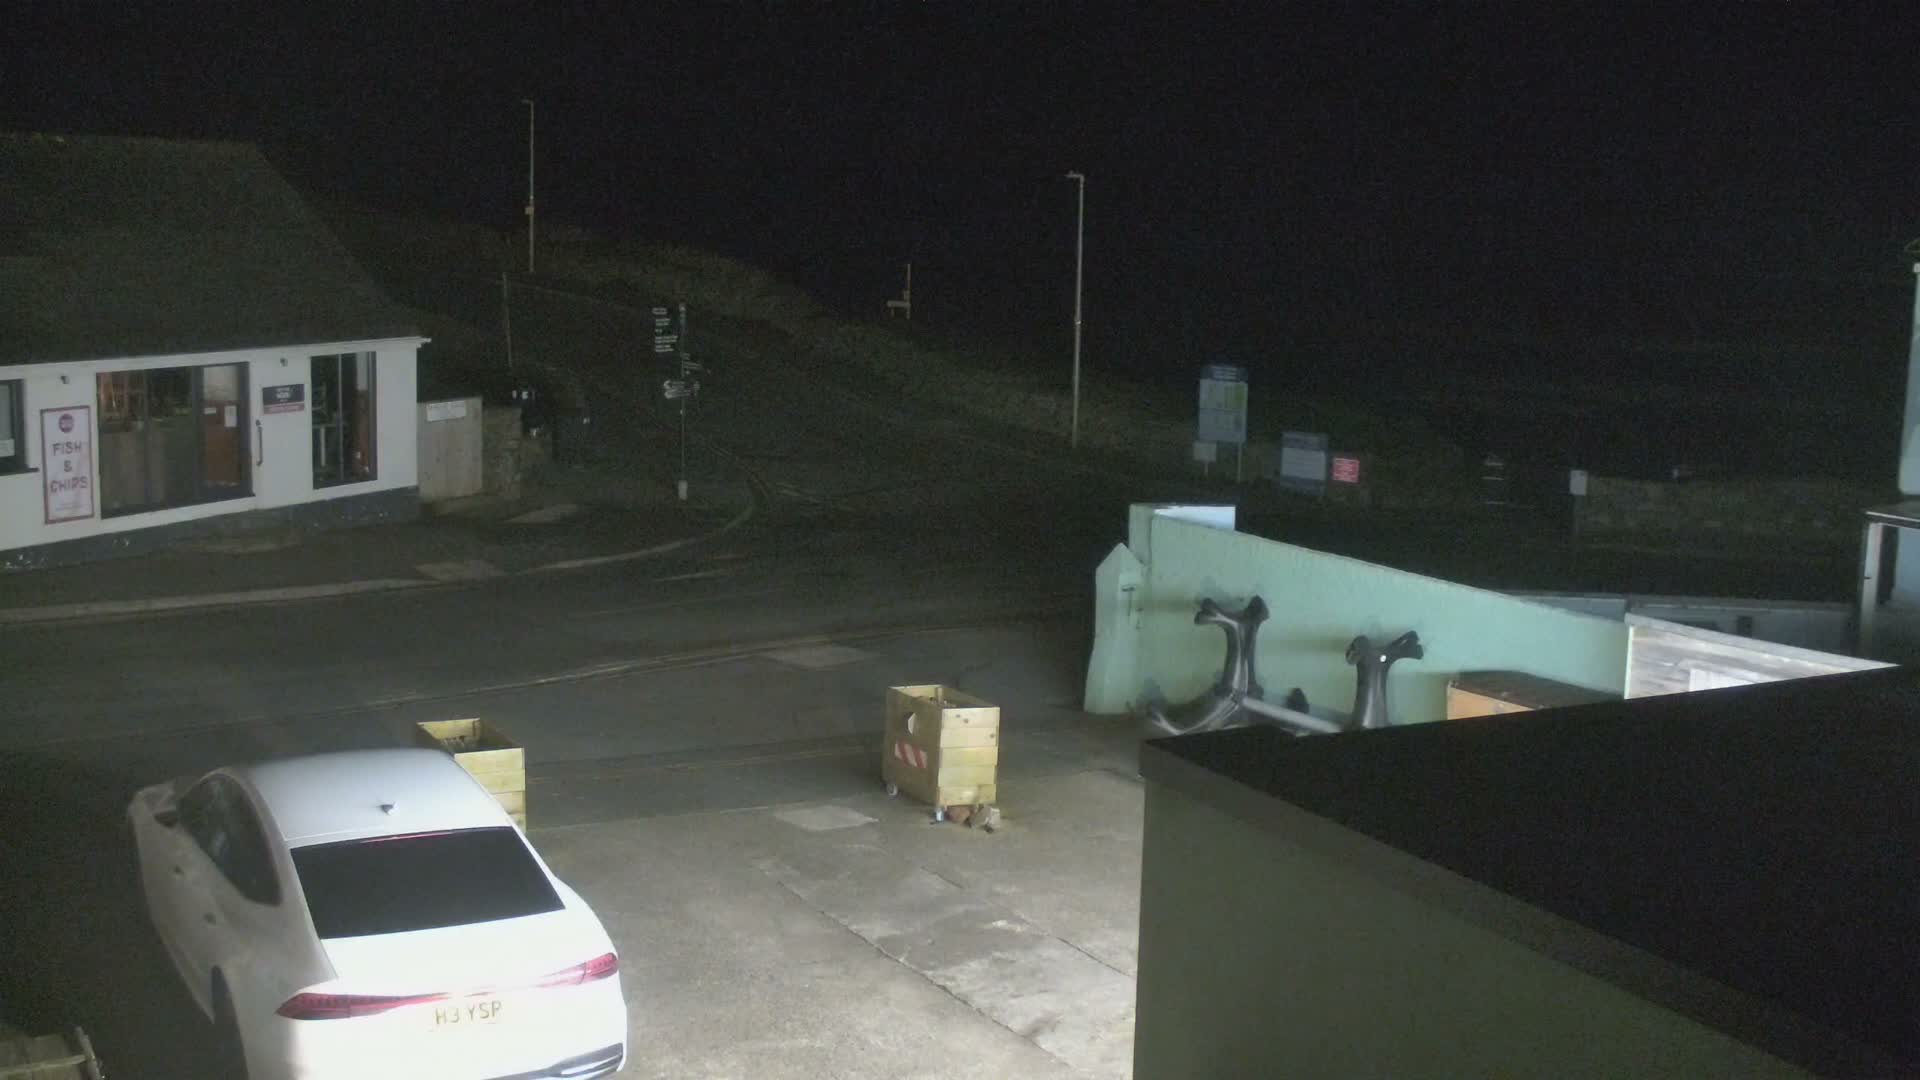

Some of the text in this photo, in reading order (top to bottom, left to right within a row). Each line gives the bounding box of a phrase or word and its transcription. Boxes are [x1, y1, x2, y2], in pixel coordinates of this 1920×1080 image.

[52, 441, 81, 456] FISH
[63, 461, 73, 472] &
[50, 477, 88, 493] CHIPS
[435, 1000, 502, 1024] H3 YSP
